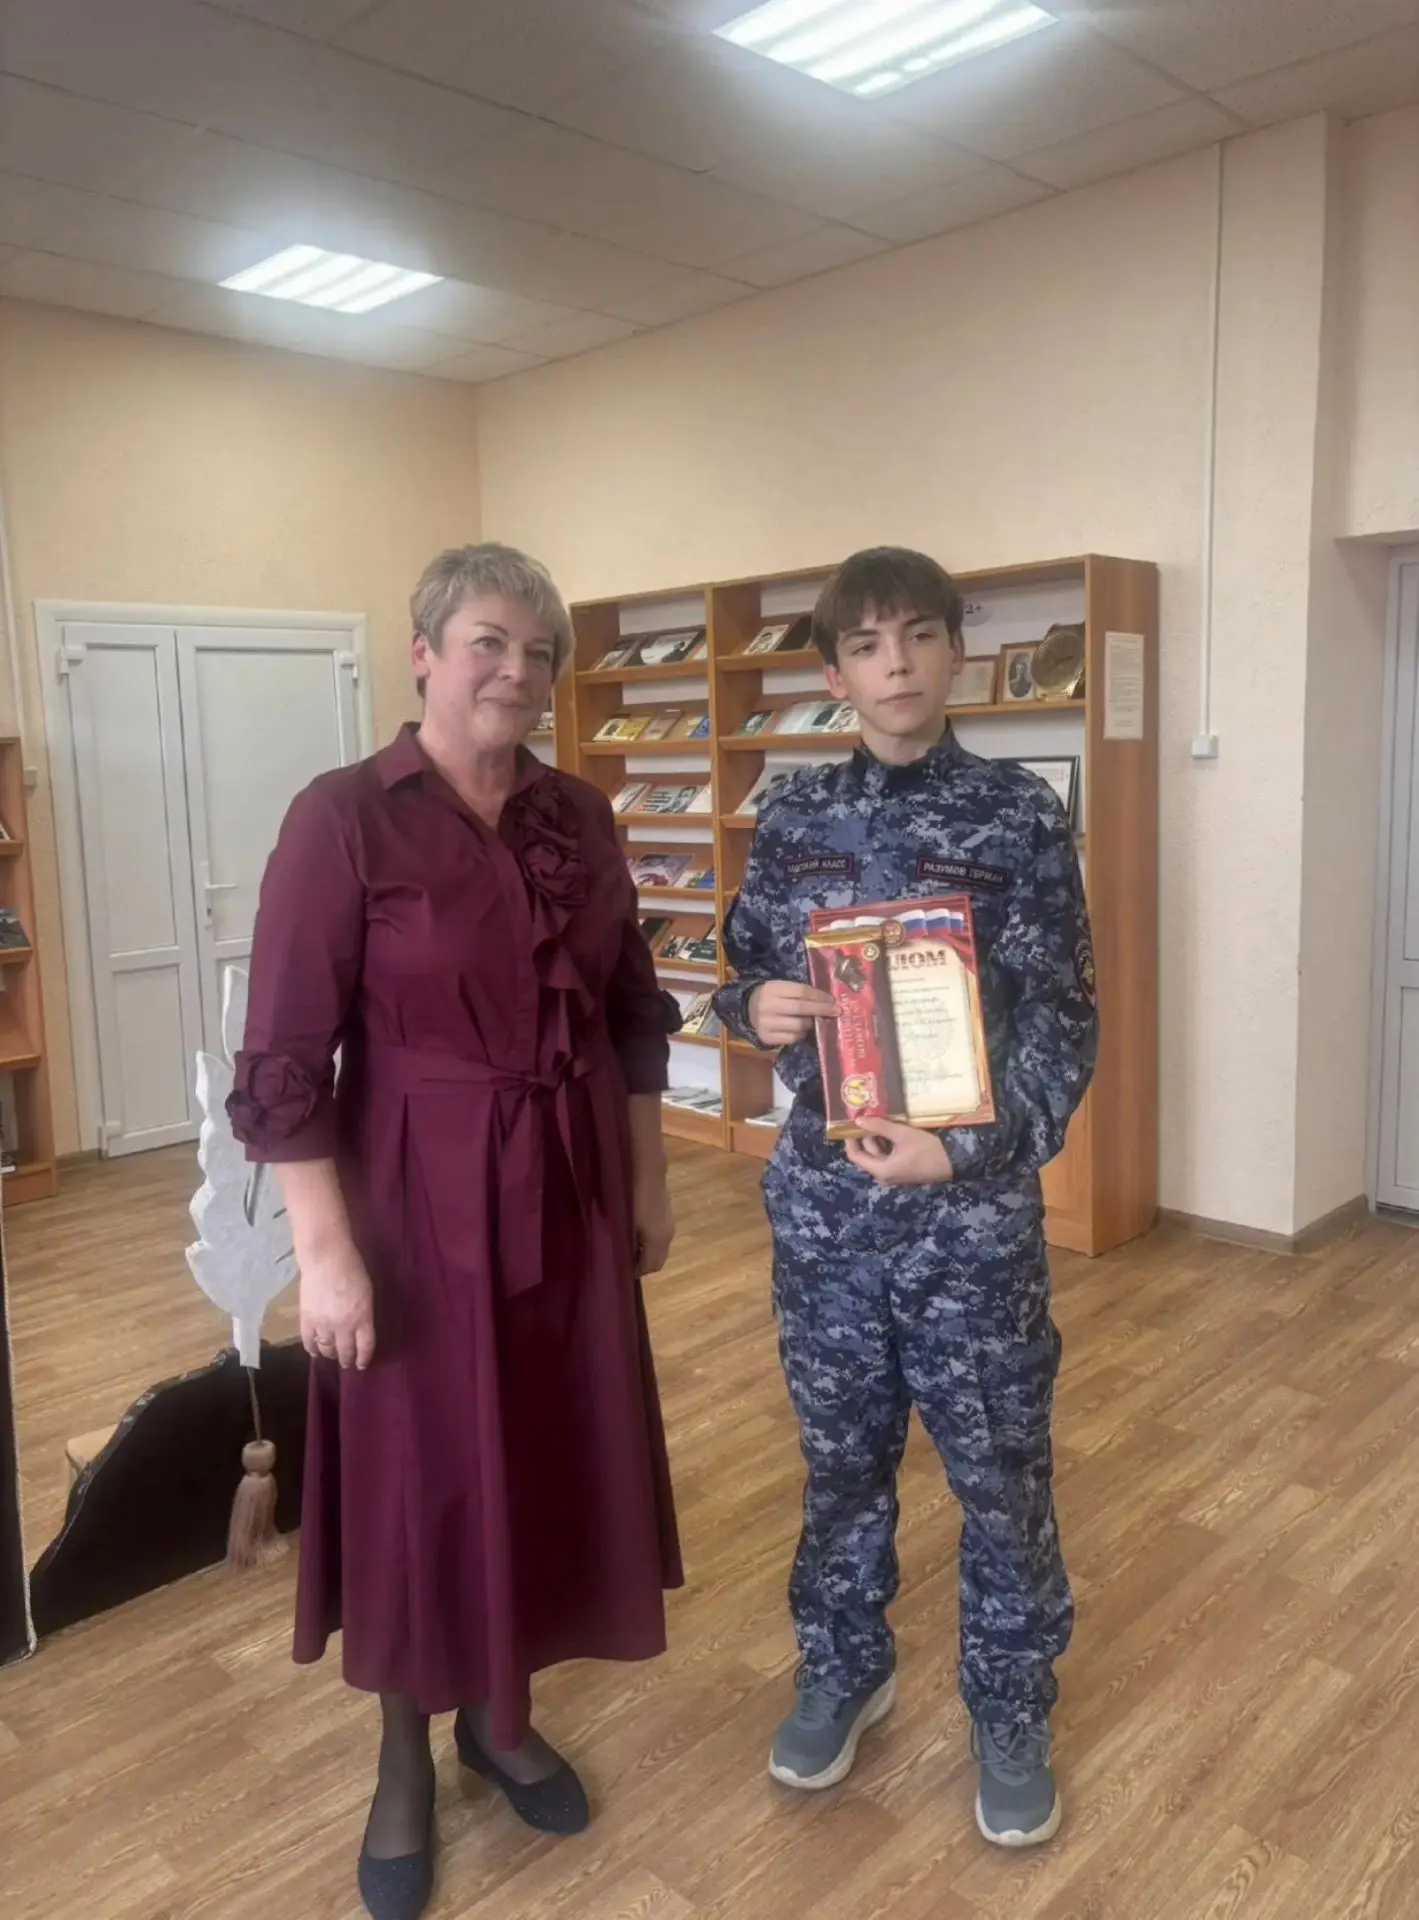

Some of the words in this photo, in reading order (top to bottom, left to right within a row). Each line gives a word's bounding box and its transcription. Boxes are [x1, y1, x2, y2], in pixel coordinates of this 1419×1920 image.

[822, 858, 847, 869] КЛАСС
[923, 861, 967, 877] РАЗУМОВ
[969, 868, 1004, 884] ГЕРМАН
[888, 949, 948, 971] ЛОМ
